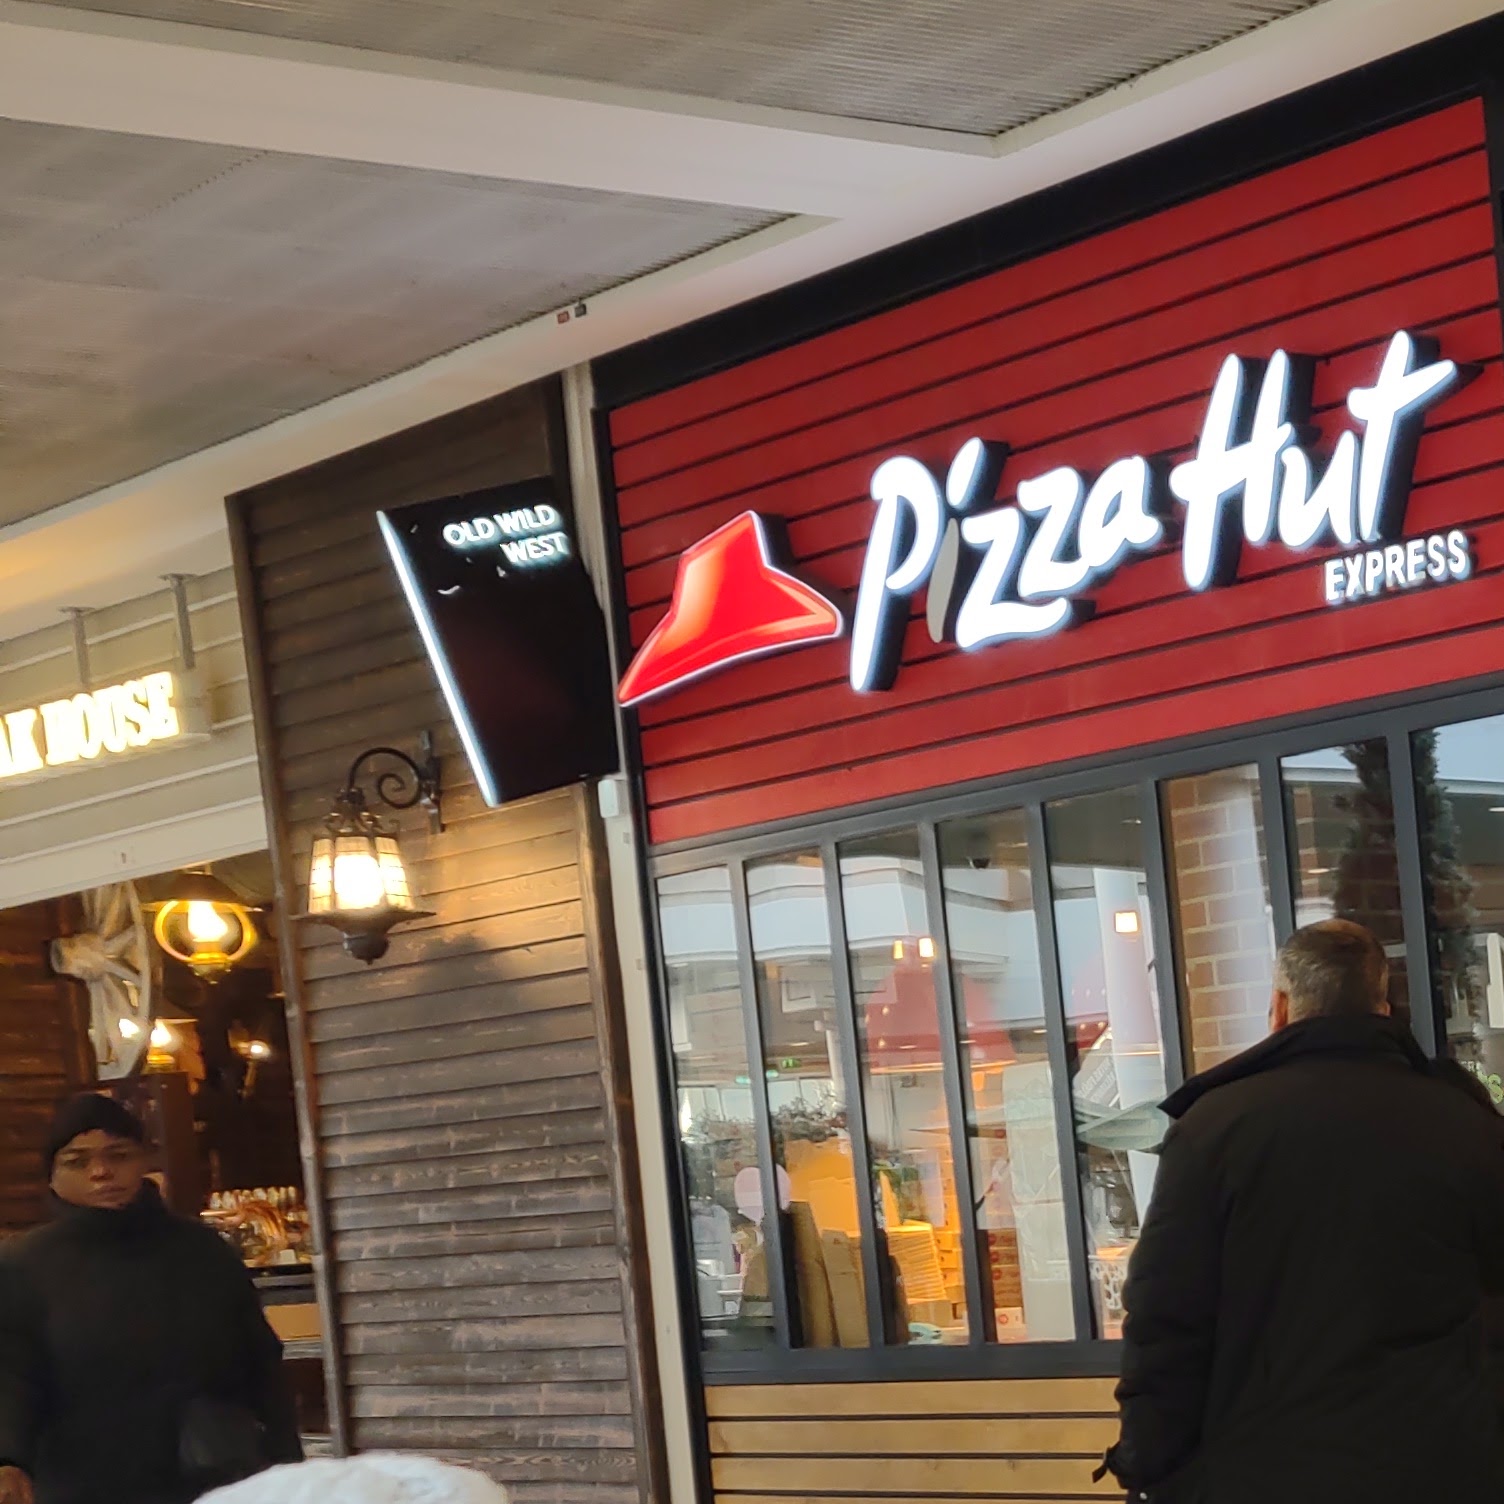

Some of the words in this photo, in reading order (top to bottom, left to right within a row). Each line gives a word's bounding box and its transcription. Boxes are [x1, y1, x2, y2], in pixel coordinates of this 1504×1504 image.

[443, 517, 496, 547] OLD
[493, 504, 558, 535] WILD
[850, 436, 1163, 692] Pizza
[1171, 329, 1459, 592] Hut
[500, 531, 570, 565] WEST
[1324, 530, 1473, 604] EXPRESS
[41, 671, 181, 767] HOUSE
